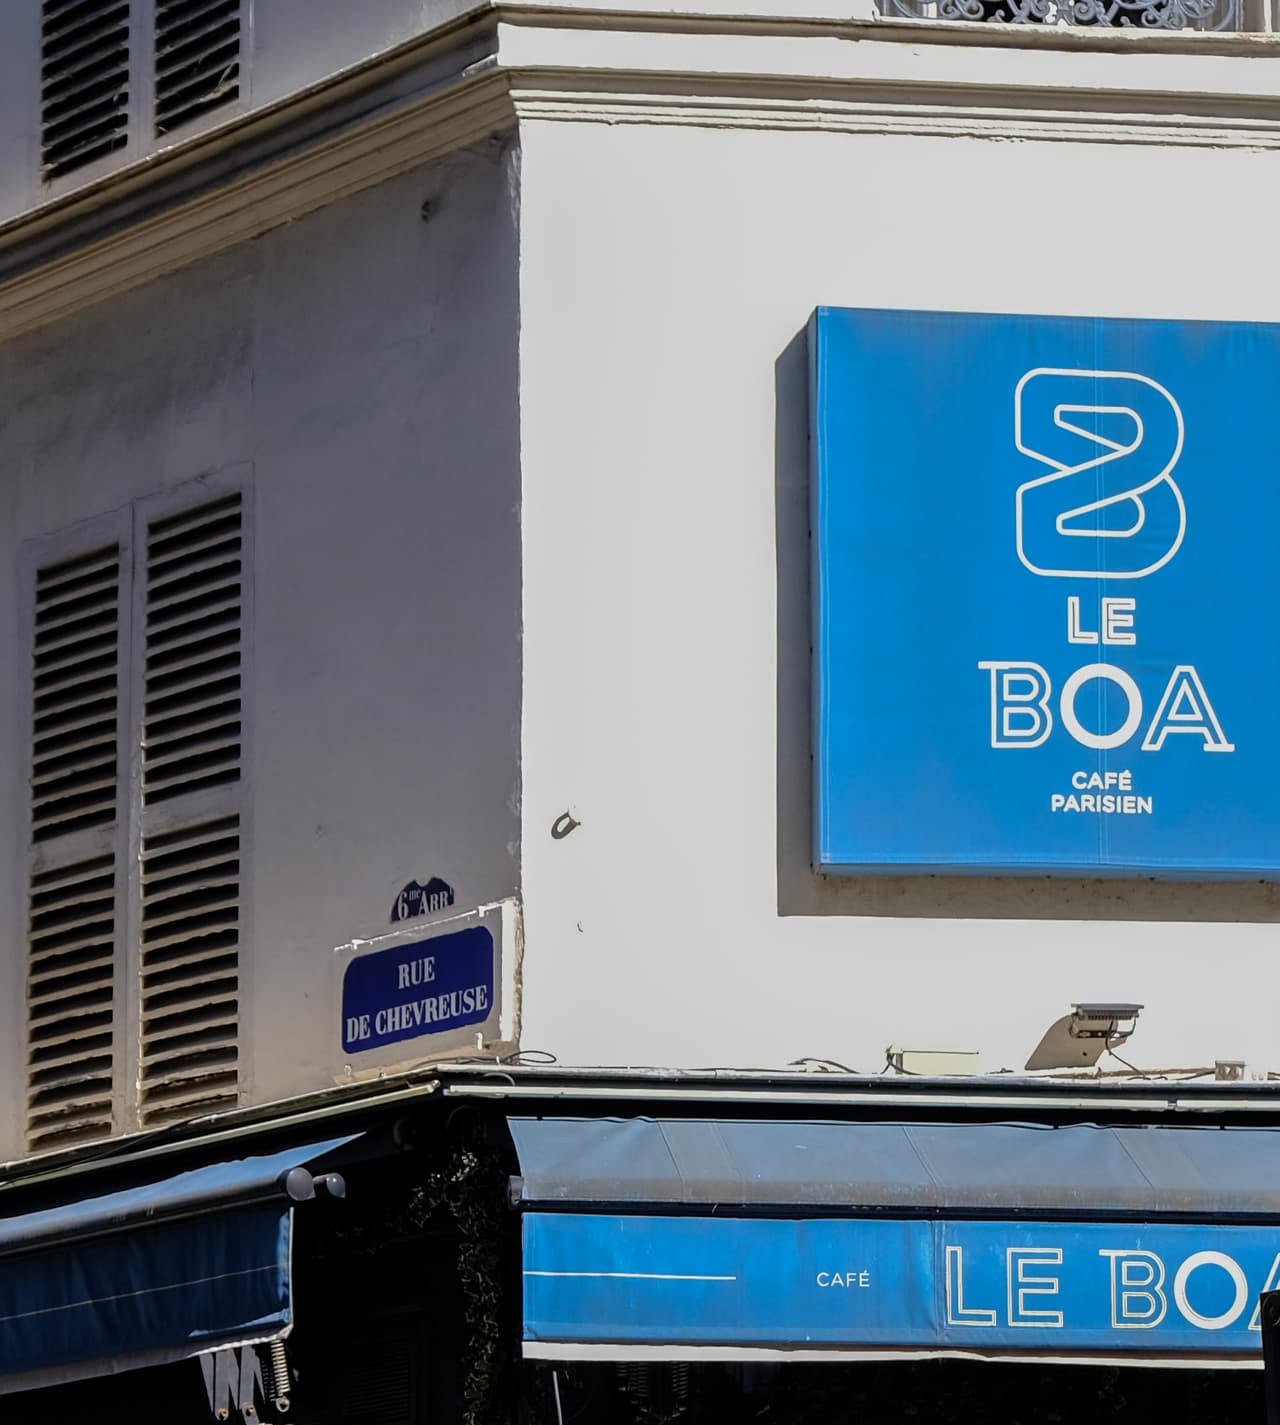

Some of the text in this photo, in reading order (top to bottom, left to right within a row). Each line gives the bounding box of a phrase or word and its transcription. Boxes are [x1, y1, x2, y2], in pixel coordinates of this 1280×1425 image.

[1067, 595, 1137, 646] LE
[977, 660, 1236, 753] BOA
[1070, 768, 1133, 792] CAFÉ
[1050, 793, 1154, 815] PARISIEN
[397, 956, 436, 990] RUE
[345, 984, 489, 1044] DE CHEVREUSE
[816, 1269, 871, 1289] CAFÉ
[944, 1245, 1065, 1329] LE
